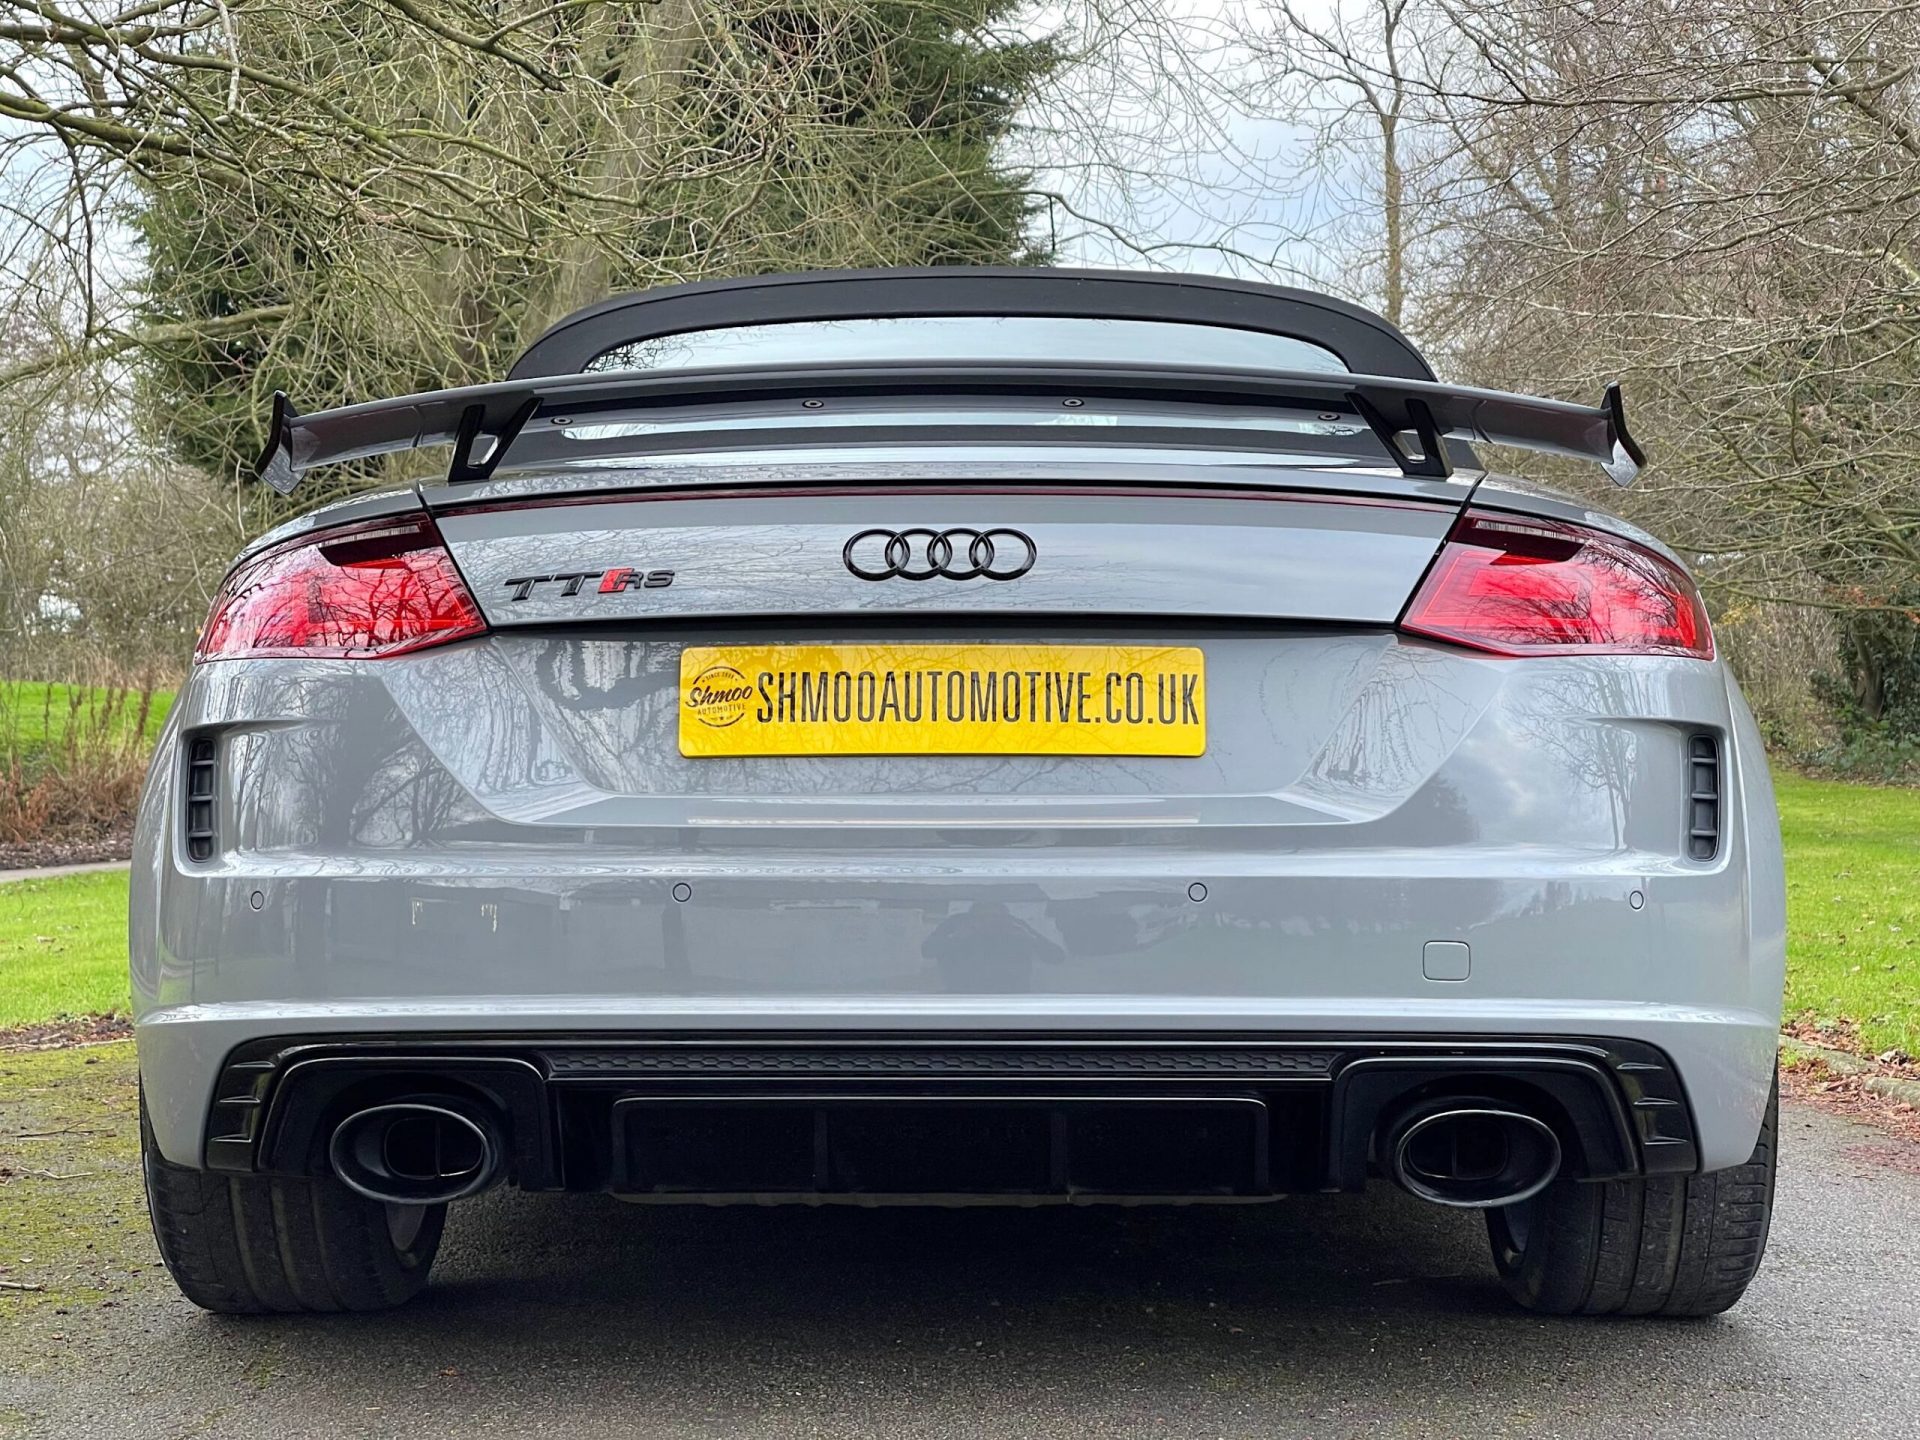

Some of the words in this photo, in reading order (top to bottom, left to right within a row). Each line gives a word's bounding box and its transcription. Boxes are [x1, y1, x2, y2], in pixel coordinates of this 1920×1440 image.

[685, 685, 753, 708] Shmoo
[757, 671, 1199, 725] SHMOOAUTOMOTIVE.CO.UK
[697, 704, 746, 716] AUTOMOTIVE
